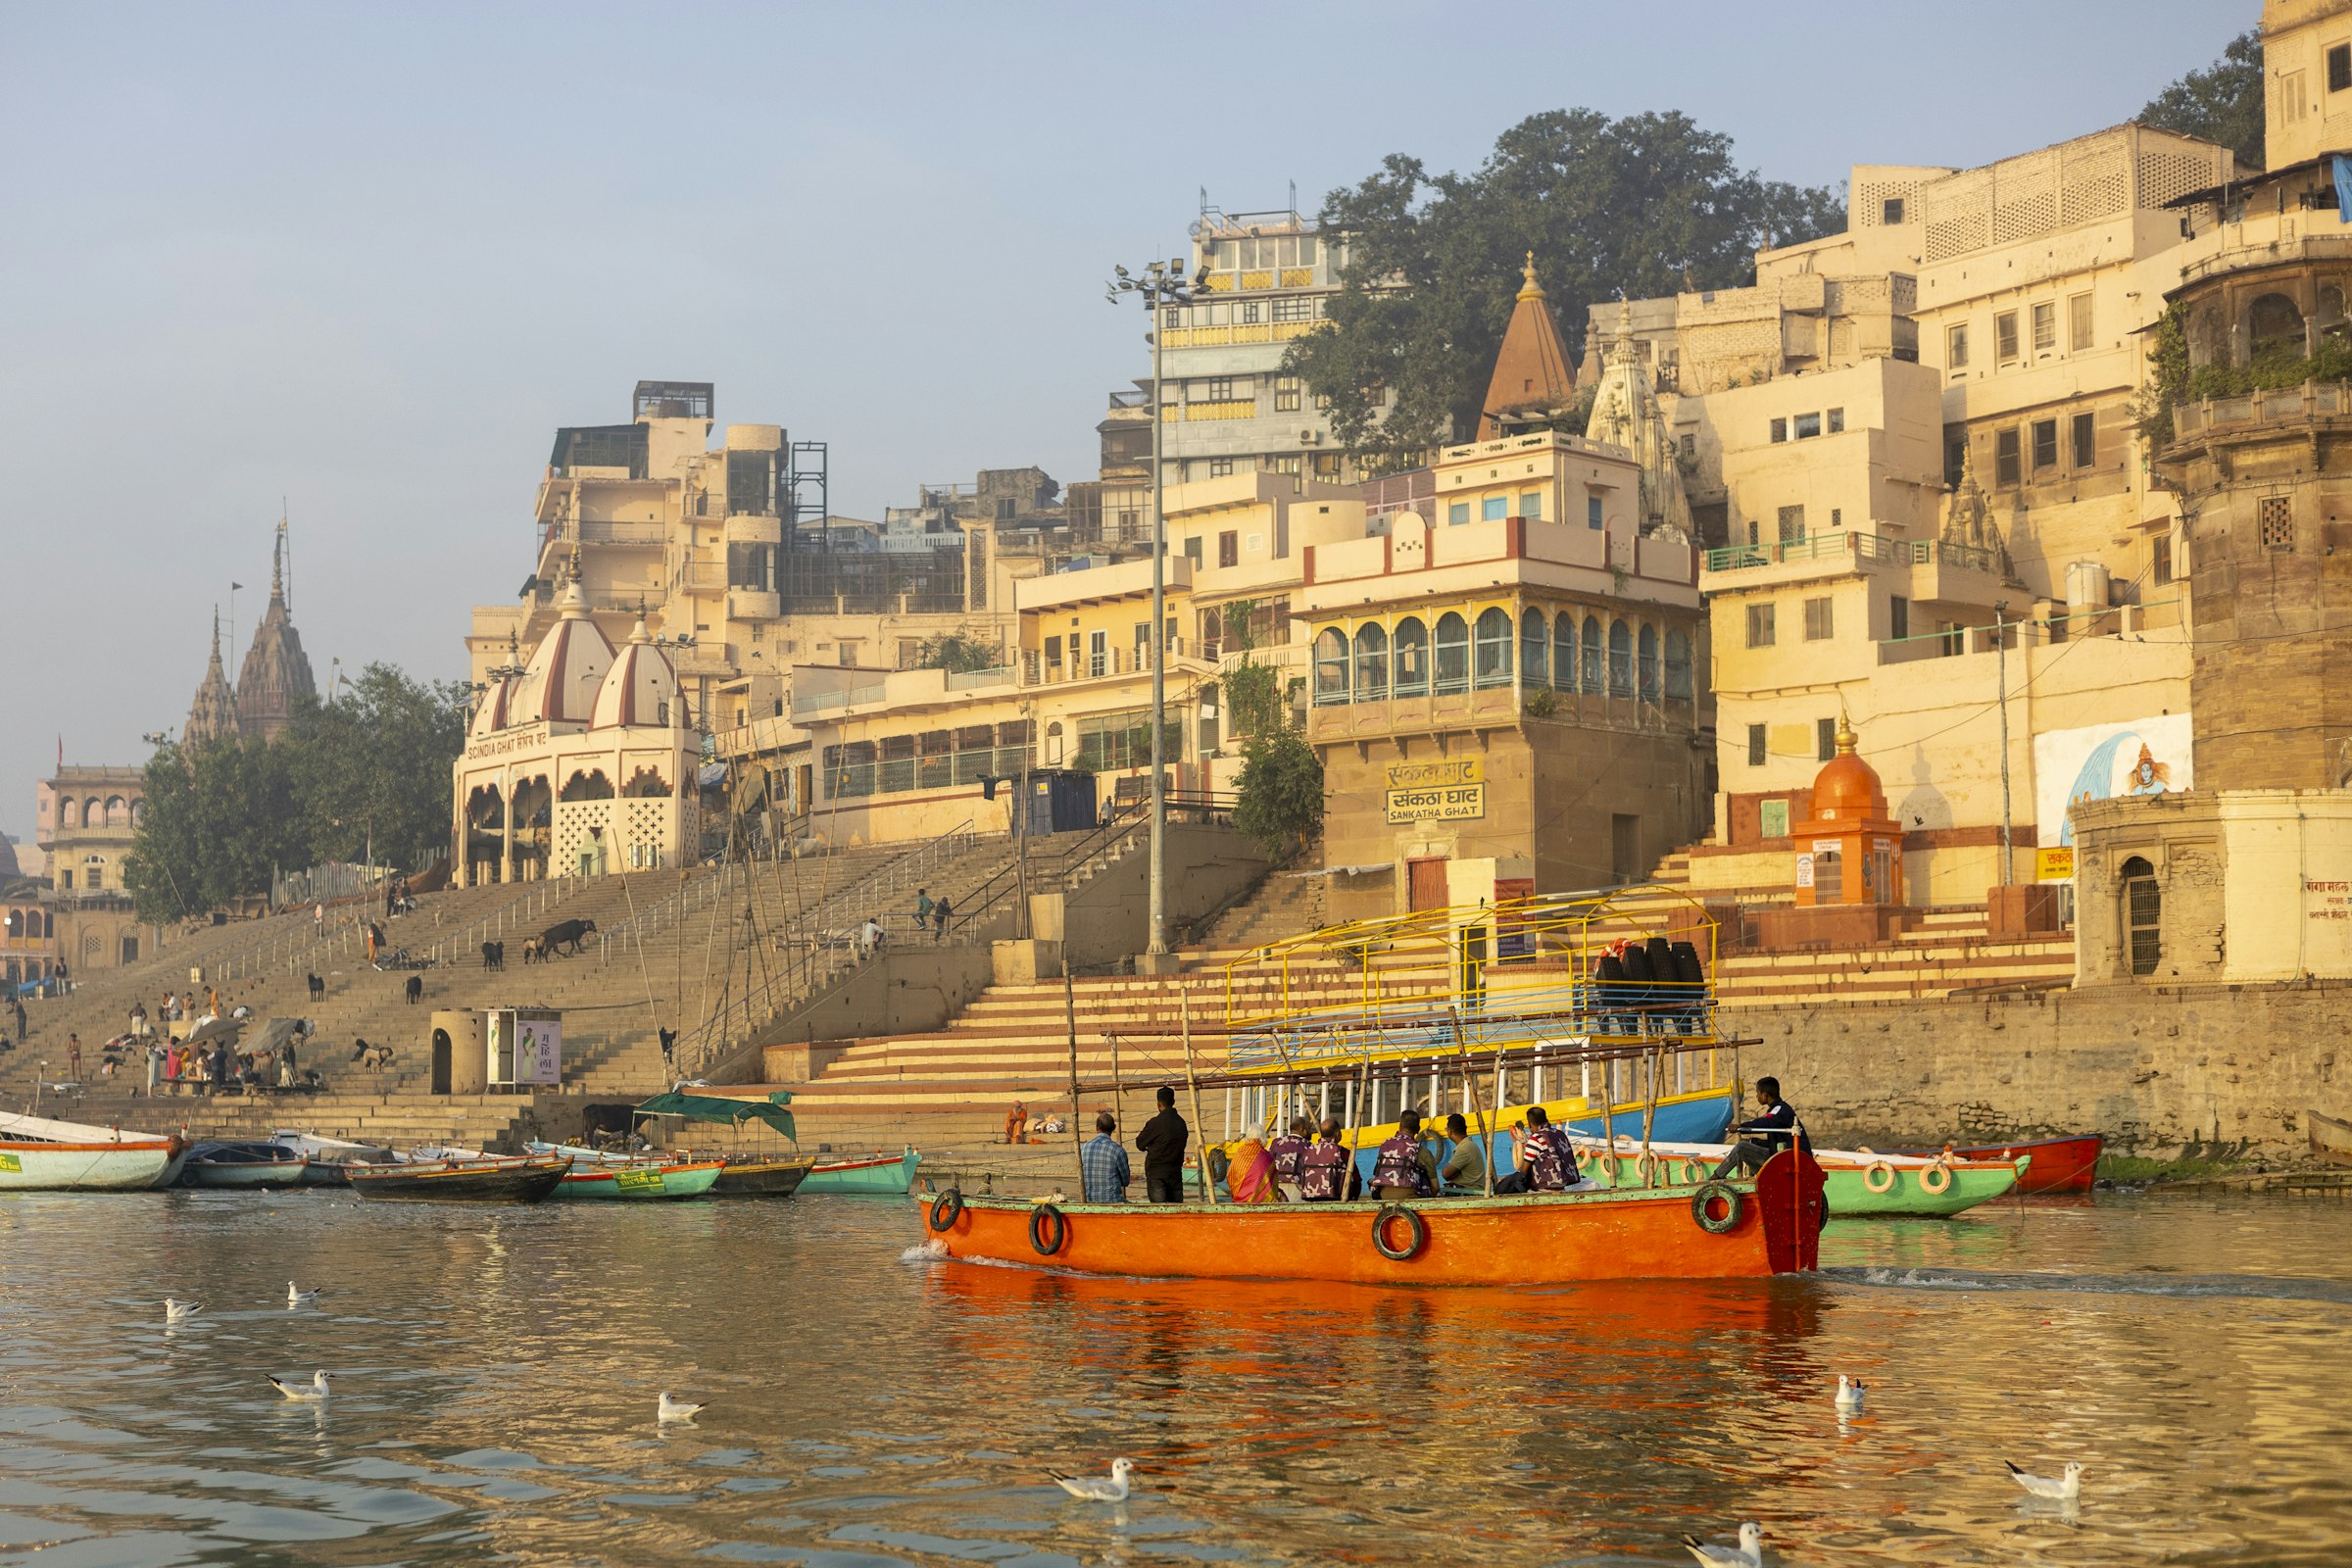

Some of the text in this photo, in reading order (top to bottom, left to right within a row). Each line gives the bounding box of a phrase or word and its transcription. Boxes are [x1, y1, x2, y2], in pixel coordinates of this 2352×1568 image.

[468, 739, 514, 760] SCINDIA GHAT
[1393, 788, 1479, 807] संकठा घाट
[1390, 806, 1478, 820] SANKATHA GHAT
